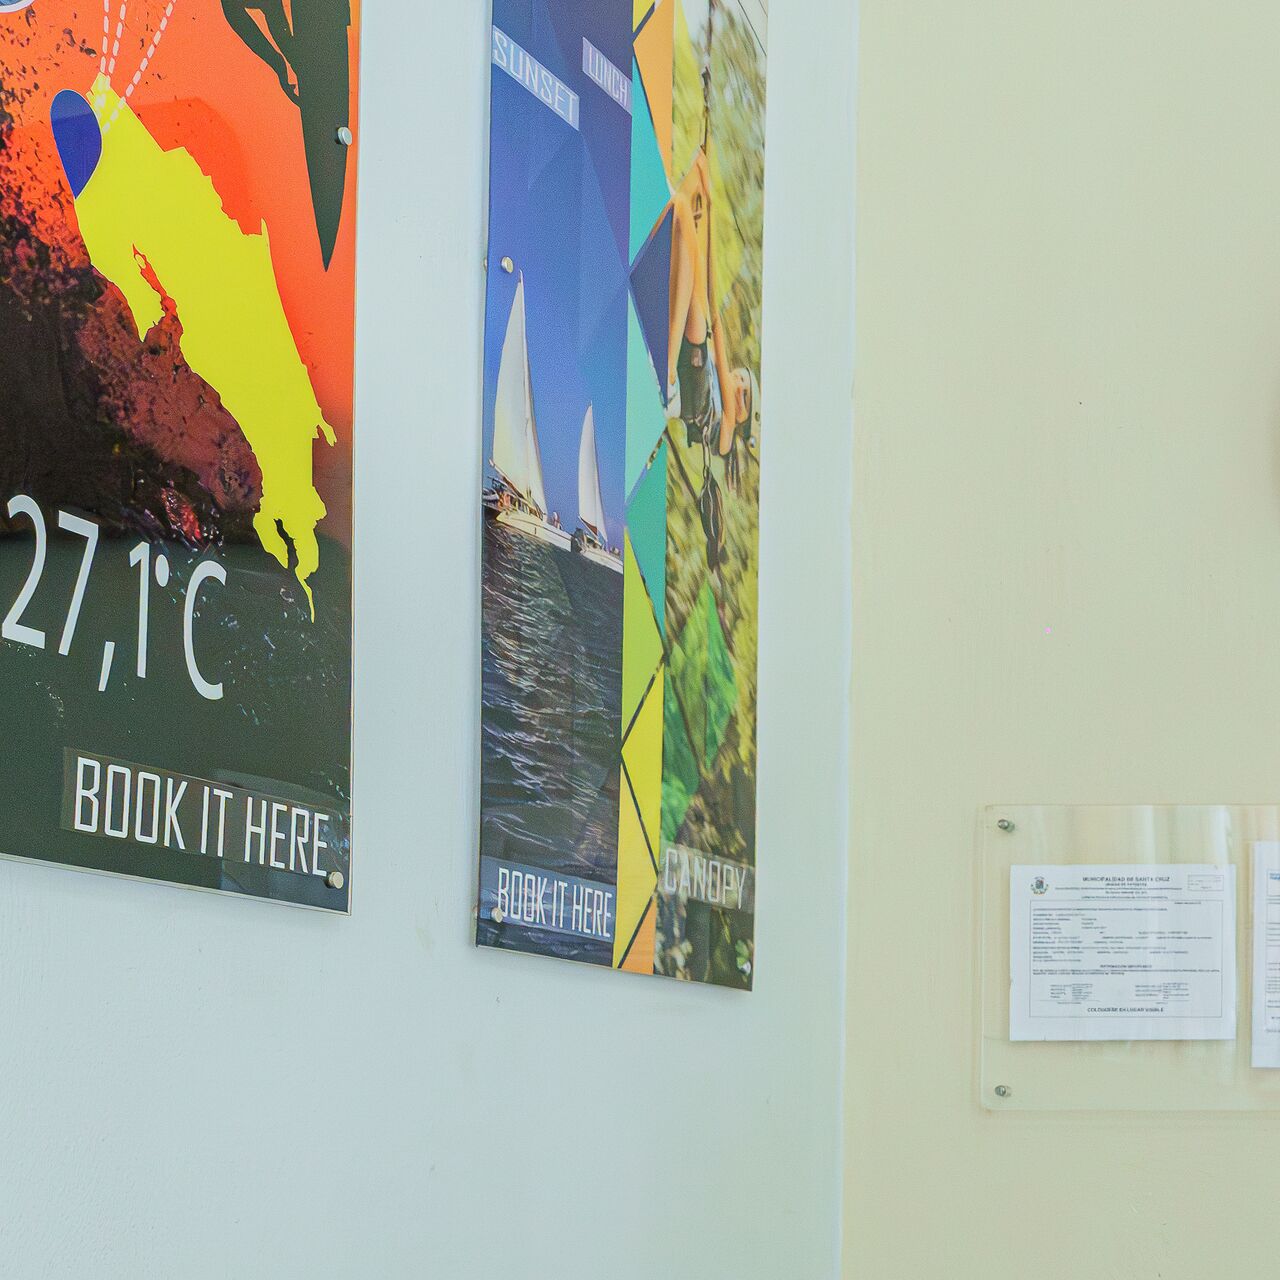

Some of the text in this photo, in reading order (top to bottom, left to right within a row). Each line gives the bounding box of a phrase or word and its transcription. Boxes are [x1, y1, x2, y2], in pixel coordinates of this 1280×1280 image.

[493, 30, 577, 123] SUNSET
[74, 757, 330, 877] BOOK IT HERE
[497, 867, 613, 938] BOOK IT HERE
[665, 848, 746, 910] CANOPY
